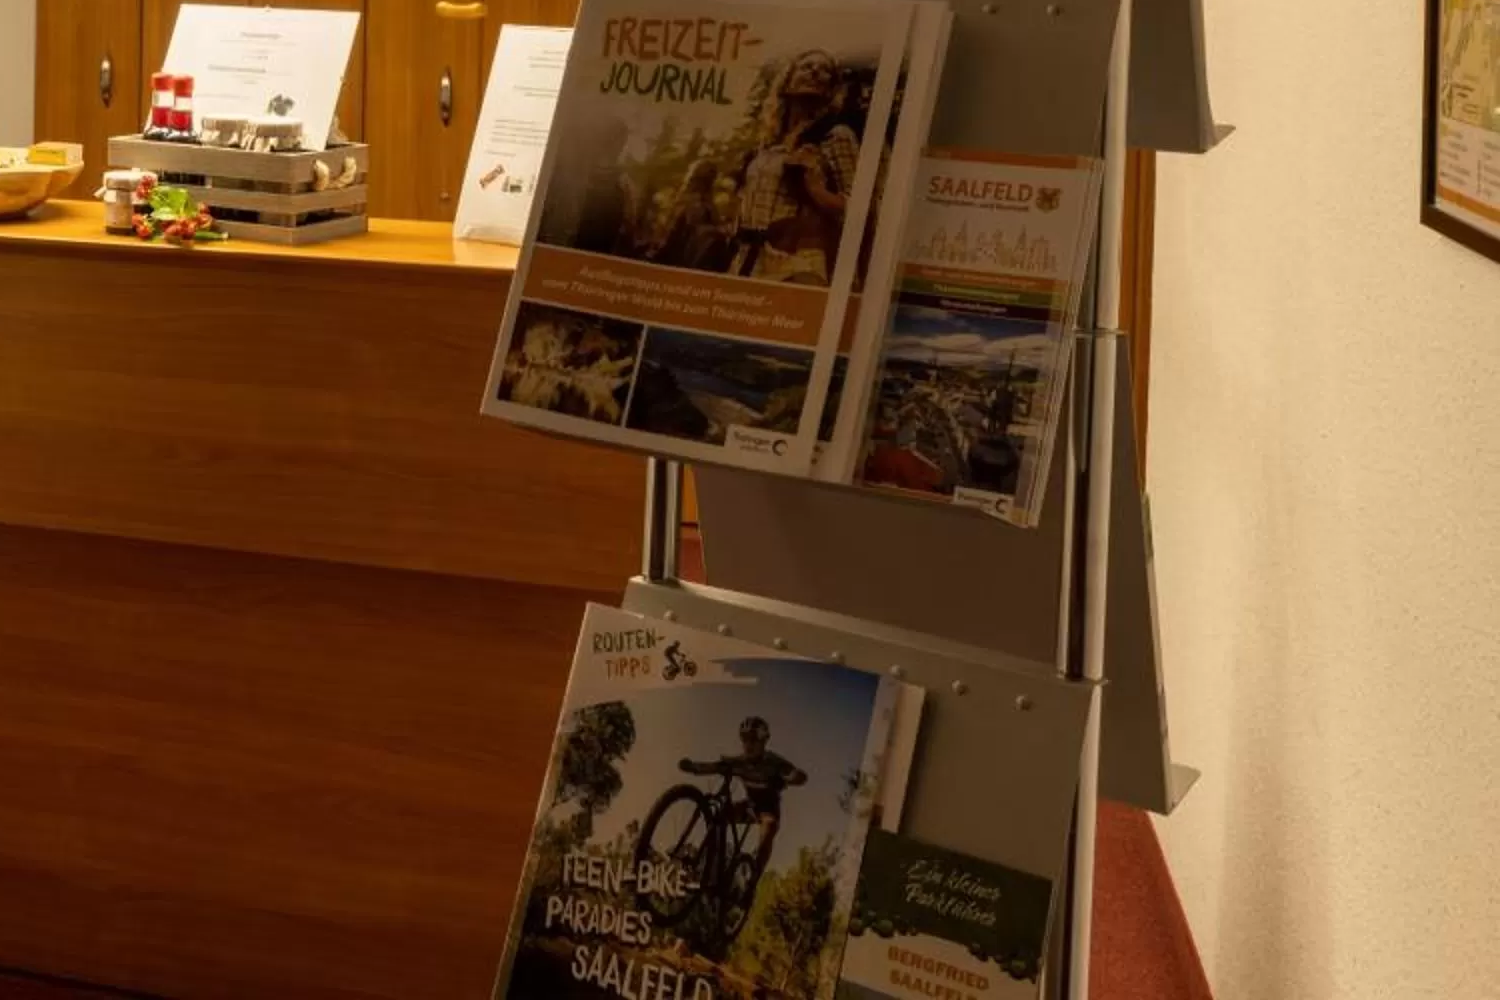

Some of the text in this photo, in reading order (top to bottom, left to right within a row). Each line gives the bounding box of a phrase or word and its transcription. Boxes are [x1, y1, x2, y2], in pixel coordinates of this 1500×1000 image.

[603, 16, 764, 63] FREIZEIT-
[600, 61, 732, 105] JOURNAL
[928, 175, 1033, 202] SAALFELD
[593, 628, 667, 653] ROUTEN-
[605, 655, 650, 681] TIPPS
[545, 895, 653, 945] PARADIES
[887, 945, 989, 991] BERGFRIED
